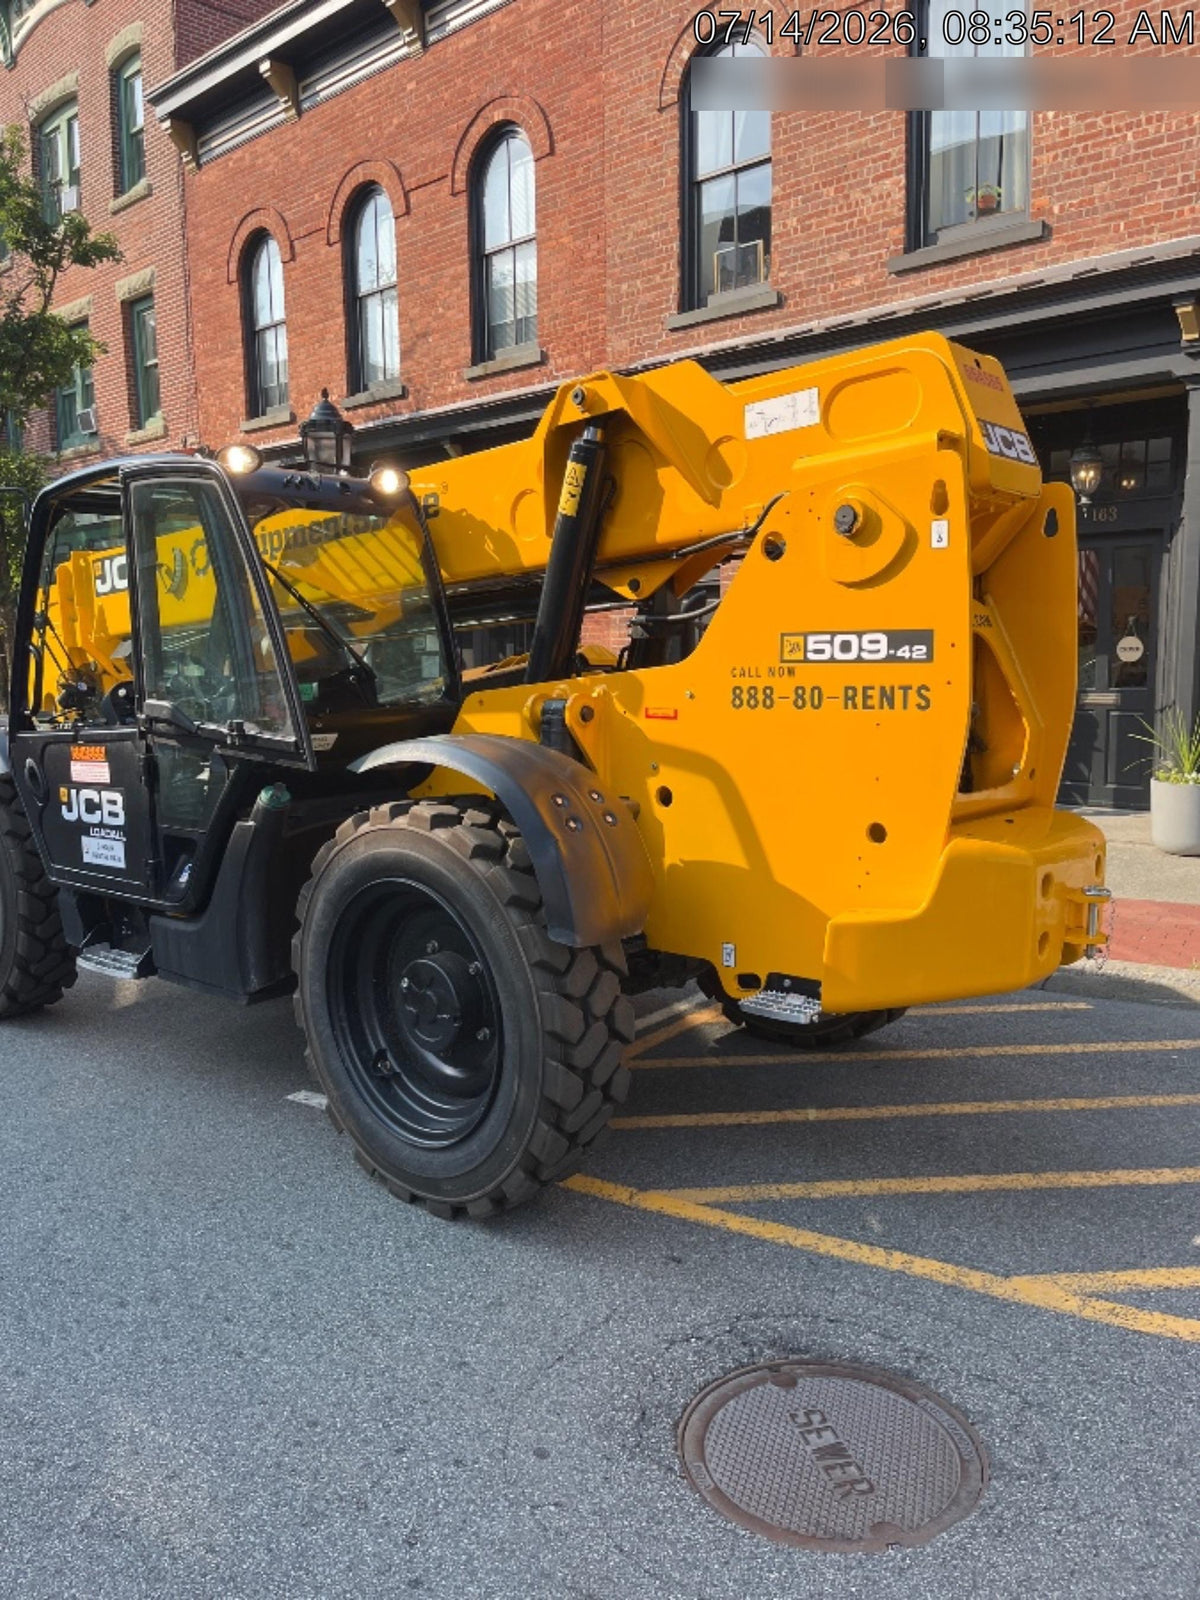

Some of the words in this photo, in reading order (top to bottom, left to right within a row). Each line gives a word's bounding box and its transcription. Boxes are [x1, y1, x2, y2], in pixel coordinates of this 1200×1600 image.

[981, 421, 1037, 463] JCB
[95, 554, 129, 593] JC
[806, 632, 928, 660] 509-42
[731, 666, 762, 679] CALL
[767, 666, 796, 678] NOW
[731, 684, 931, 711] 888-80-RENTS
[60, 788, 126, 826] JCB
[789, 1408, 875, 1499] SEWER
